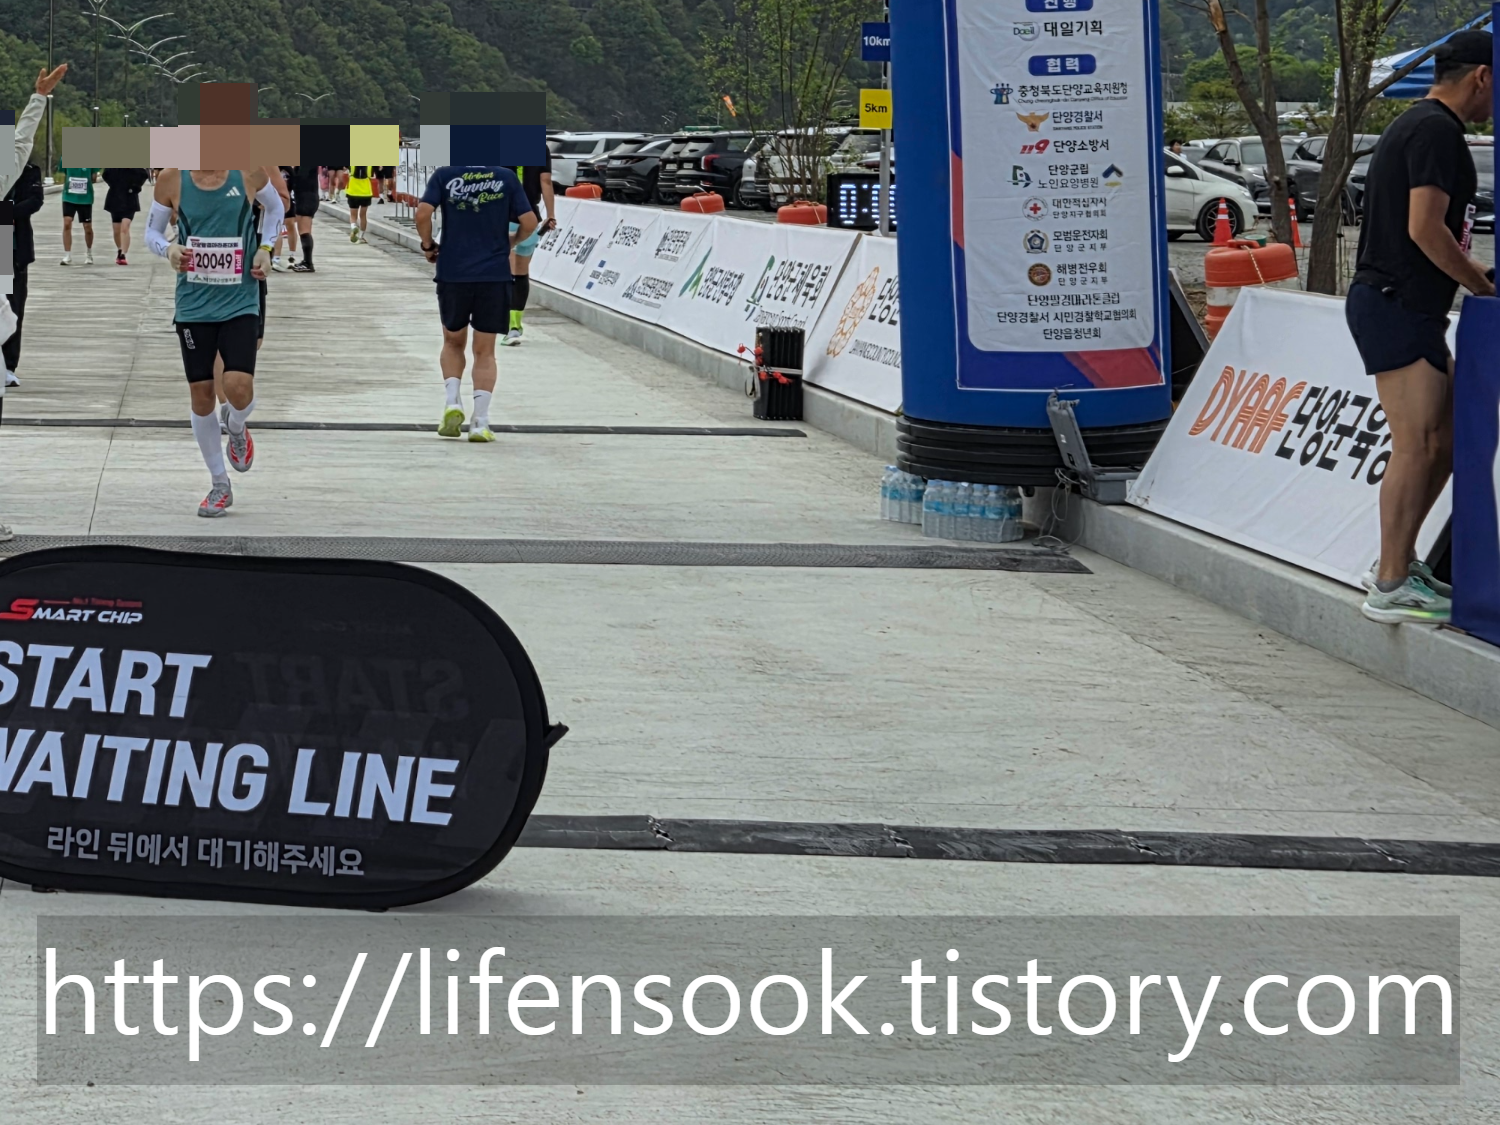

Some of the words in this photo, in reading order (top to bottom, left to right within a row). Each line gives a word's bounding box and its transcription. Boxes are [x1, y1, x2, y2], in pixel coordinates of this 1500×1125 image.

[1044, 20, 1103, 37] 대일기획
[1046, 57, 1079, 73] 협력
[1018, 82, 1128, 97] 충청북도단양교육지원청
[864, 103, 888, 113] 5km
[1052, 110, 1103, 124] 단양경찰서
[1019, 139, 1050, 154] 119
[1053, 138, 1110, 153] 단양소방서
[1048, 163, 1089, 175] 단양군립
[445, 177, 504, 198] Running
[1038, 176, 1099, 190] 노인요양병원
[1052, 197, 1107, 208] 대한적십자사
[1052, 229, 1108, 242] 모범운전자회
[195, 252, 233, 269] 20049
[1056, 262, 1107, 275] 해병전우회
[1027, 292, 1120, 307] 단양팔경마라톤클럽
[997, 311, 1050, 324] 단양경찰서
[1053, 308, 1137, 324] 시민경찰학교협의회
[1043, 327, 1101, 340] 단양읍청년회
[1188, 365, 1308, 455] DYAAF
[97, 610, 143, 624] CHIP
[287, 748, 461, 826] LINE
[46, 825, 101, 861] 라인
[106, 830, 190, 868] 뒤에서
[196, 837, 365, 878] 대기해주세요
